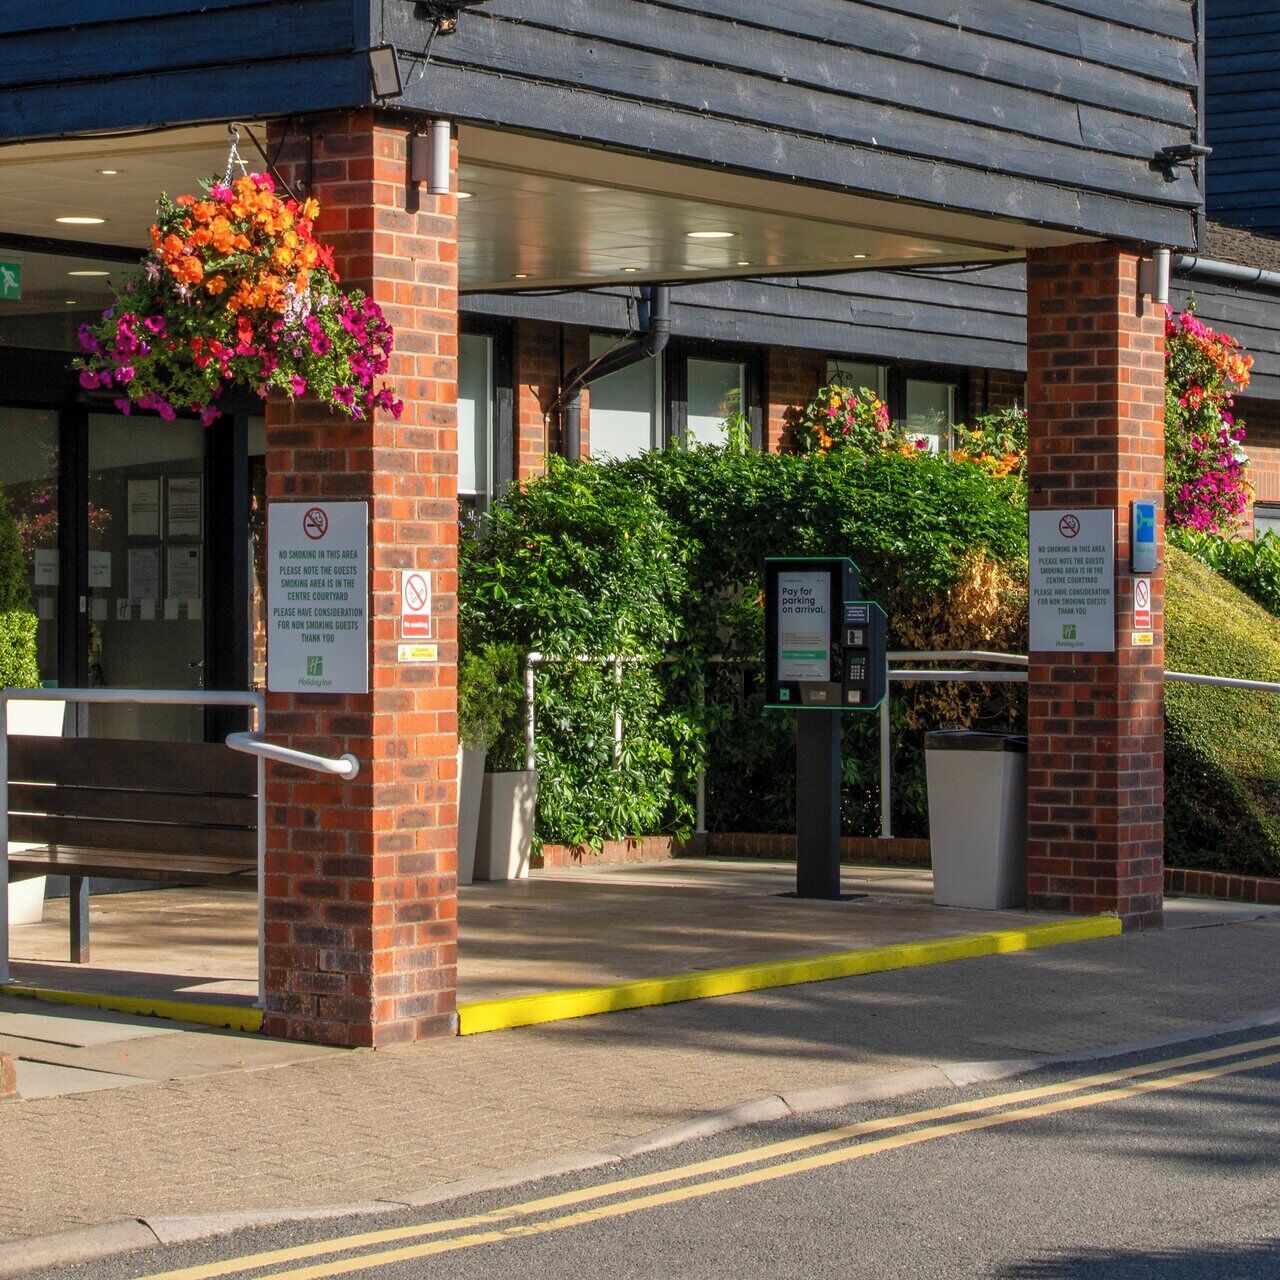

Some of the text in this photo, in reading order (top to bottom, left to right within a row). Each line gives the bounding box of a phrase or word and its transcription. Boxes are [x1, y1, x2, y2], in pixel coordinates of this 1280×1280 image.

[1038, 545, 1106, 553] NO SMOKING IN THIS AREA
[278, 550, 358, 559] NO SMOKING IN THIS AREA
[1038, 557, 1105, 565] PLEASE NOTE THE GUESTS
[279, 565, 357, 575] PLEASE NOTE THE GUESTS
[280, 579, 355, 588] SMOKING AREA IS IN THE
[1046, 576, 1098, 584] CENTRE COURTYARD
[287, 591, 349, 601] CENTRE COURTYARD
[782, 587, 812, 596] Pay for
[1033, 588, 1111, 596] PLEASE HAVE CONSIDERATION
[782, 596, 816, 606] parking
[273, 607, 363, 617] PLEASE HAVE CONSIDERATION
[782, 605, 826, 614] on arrival.
[1057, 607, 1087, 615] THANK YOU
[277, 620, 359, 630] FOR NON SMOKING GUESTS
[301, 633, 335, 643] THANK YOU
[298, 677, 332, 687] Holiday Inn
